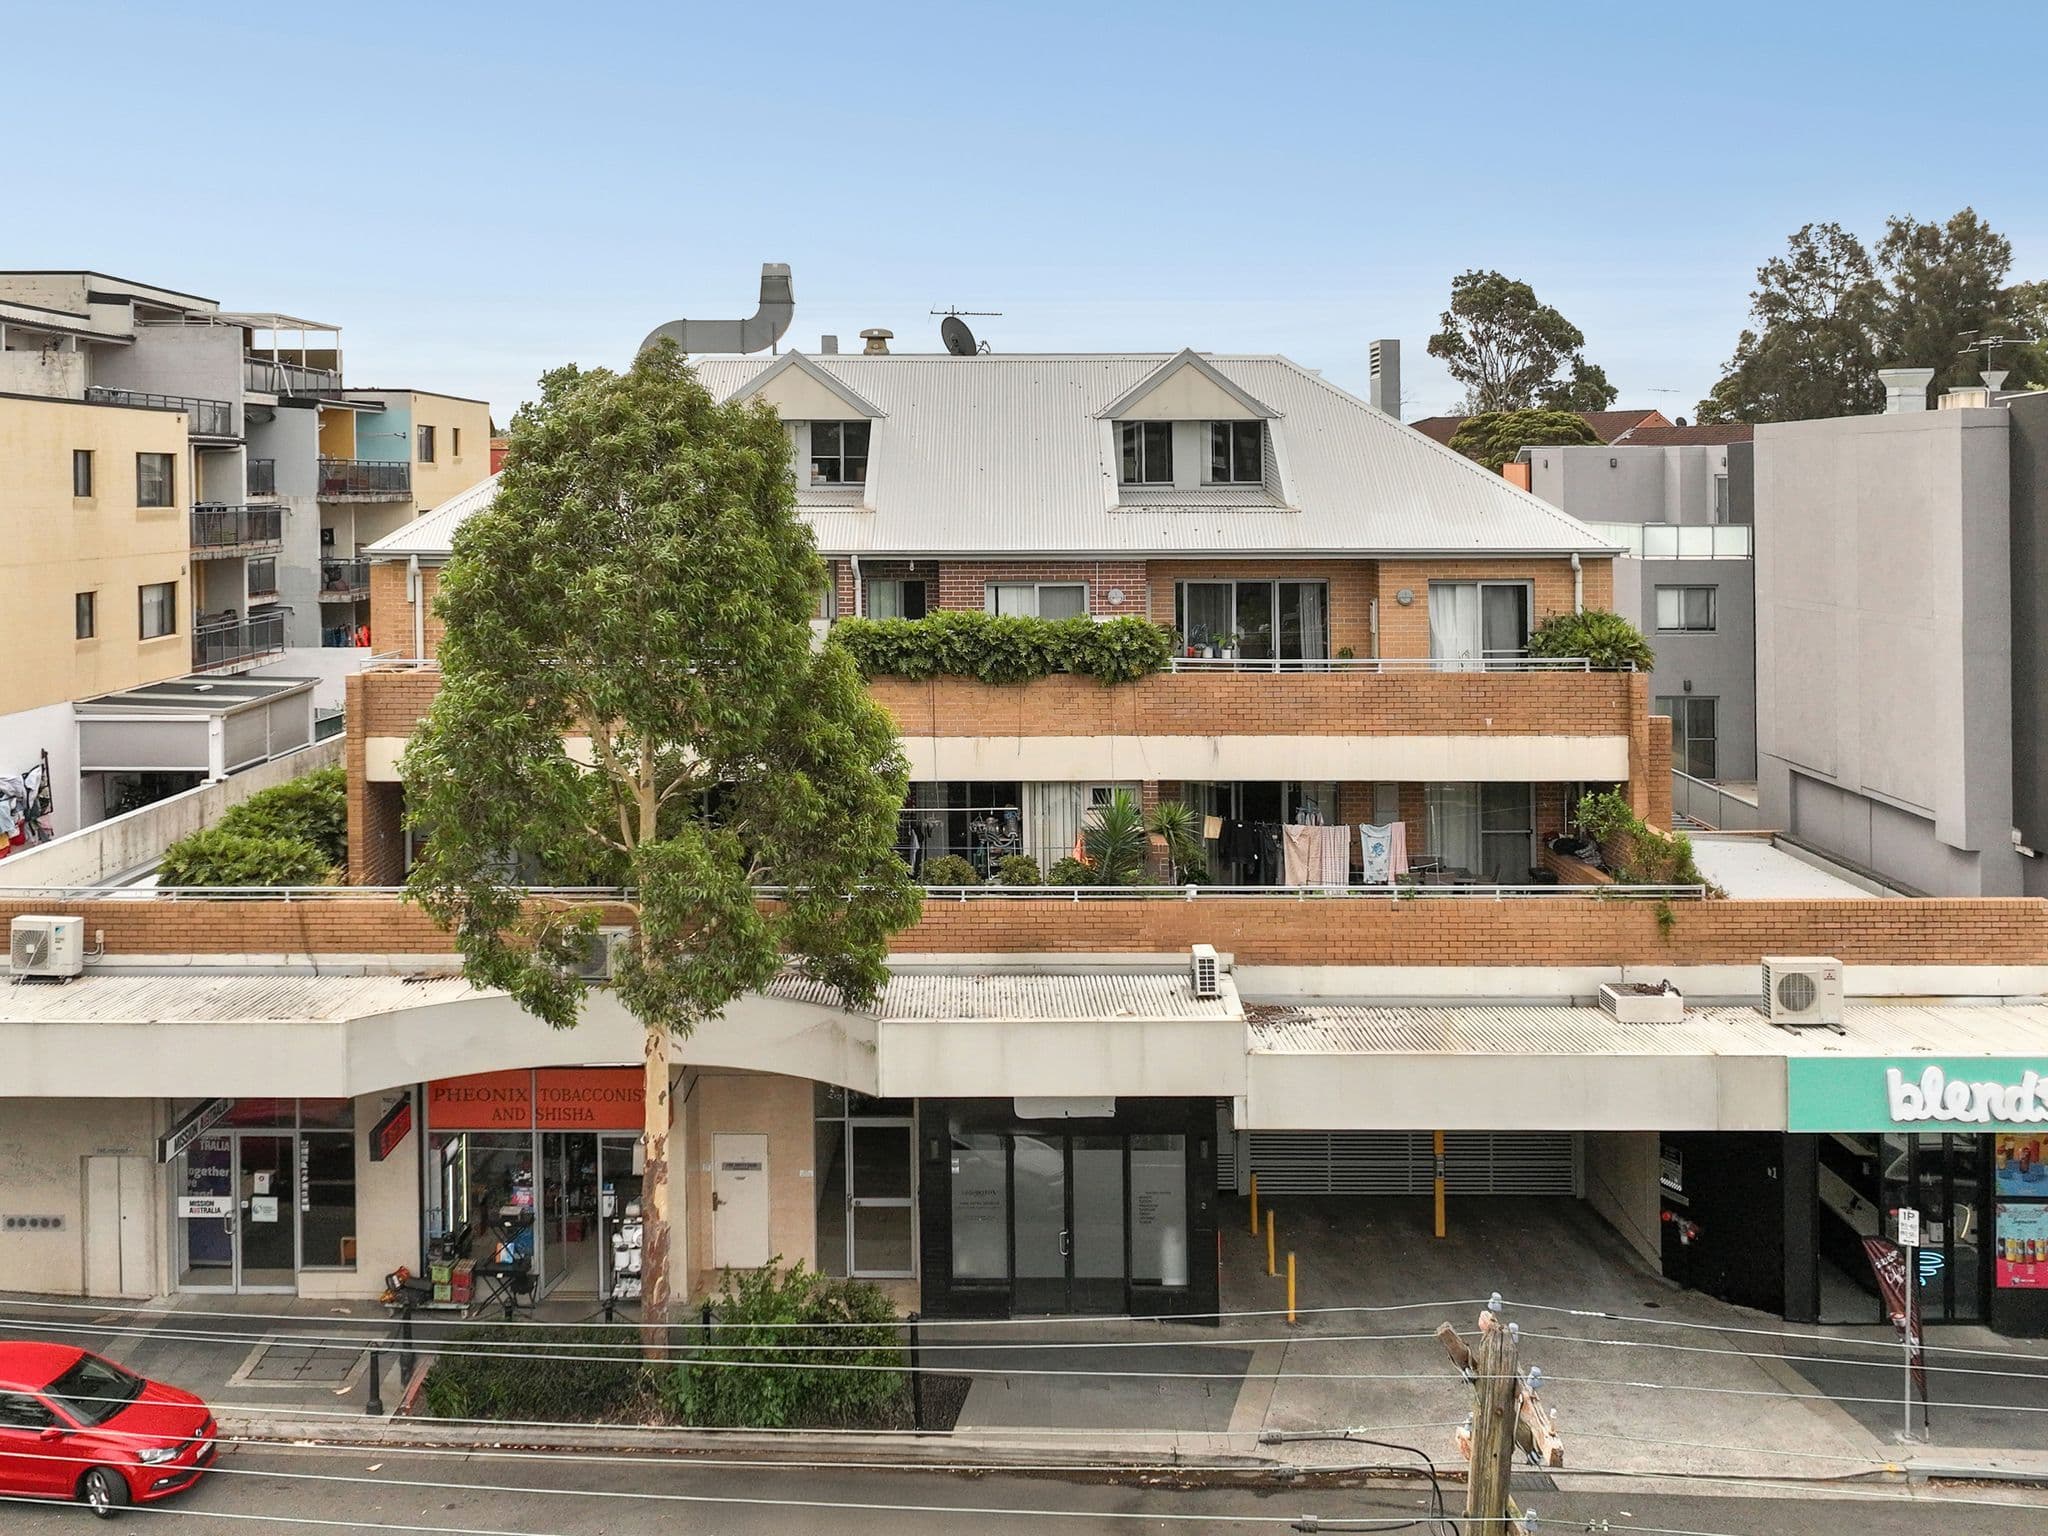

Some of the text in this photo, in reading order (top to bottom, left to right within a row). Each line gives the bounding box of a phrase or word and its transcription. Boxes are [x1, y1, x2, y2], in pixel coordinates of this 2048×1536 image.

[433, 1087, 529, 1102] PHEONIX
[491, 1107, 596, 1121] AND SHISHA
[198, 1140, 231, 1151] TRALIA
[188, 1166, 230, 1179] ogether
[1903, 1211, 1916, 1221] 1P
